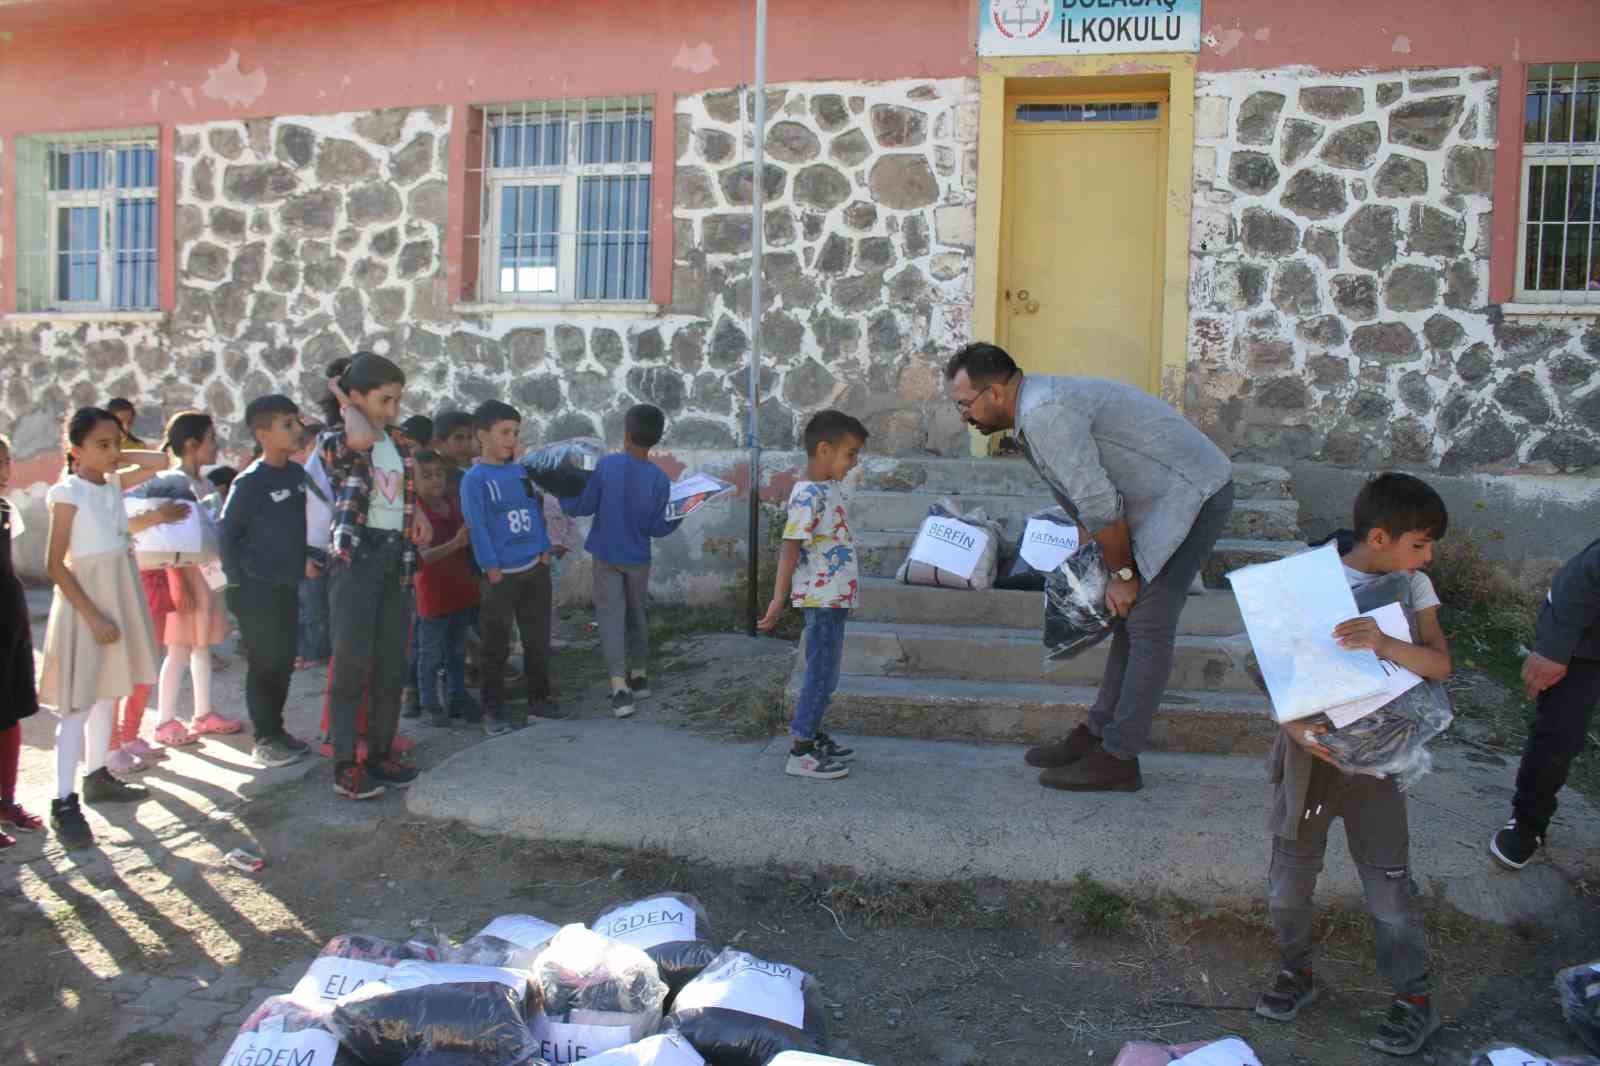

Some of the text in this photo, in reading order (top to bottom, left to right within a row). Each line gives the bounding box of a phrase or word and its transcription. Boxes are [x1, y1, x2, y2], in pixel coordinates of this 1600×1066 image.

[1060, 13, 1181, 43] İLKOKULU
[508, 509, 532, 533] 85
[929, 521, 976, 549] BERFİN
